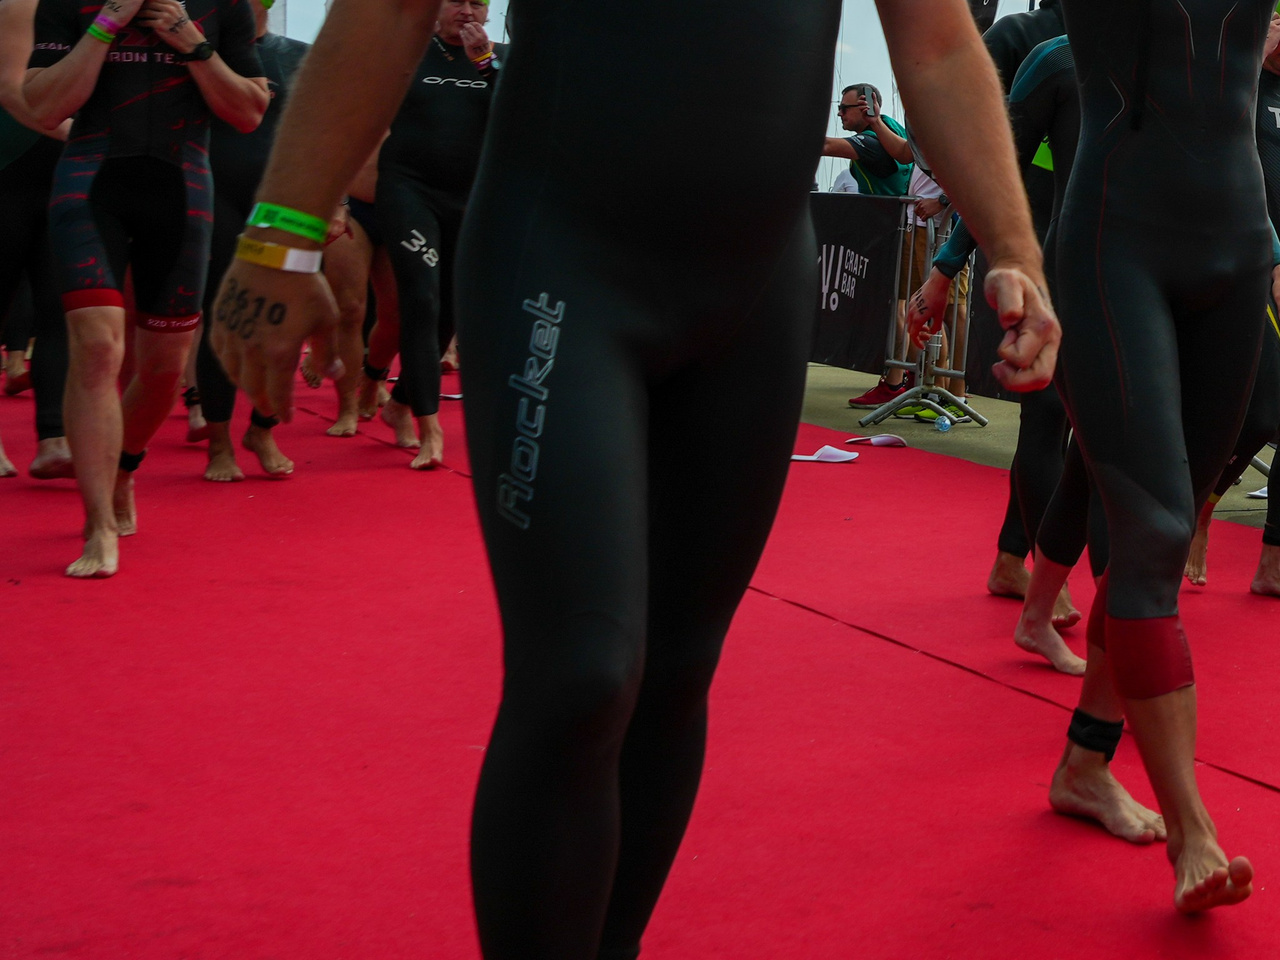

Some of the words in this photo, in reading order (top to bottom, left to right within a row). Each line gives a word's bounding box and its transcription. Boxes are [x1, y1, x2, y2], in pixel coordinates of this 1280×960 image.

[422, 76, 488, 89] orca
[844, 248, 870, 279] CRAFT
[841, 272, 856, 299] BAR
[498, 291, 566, 530] Rocket
